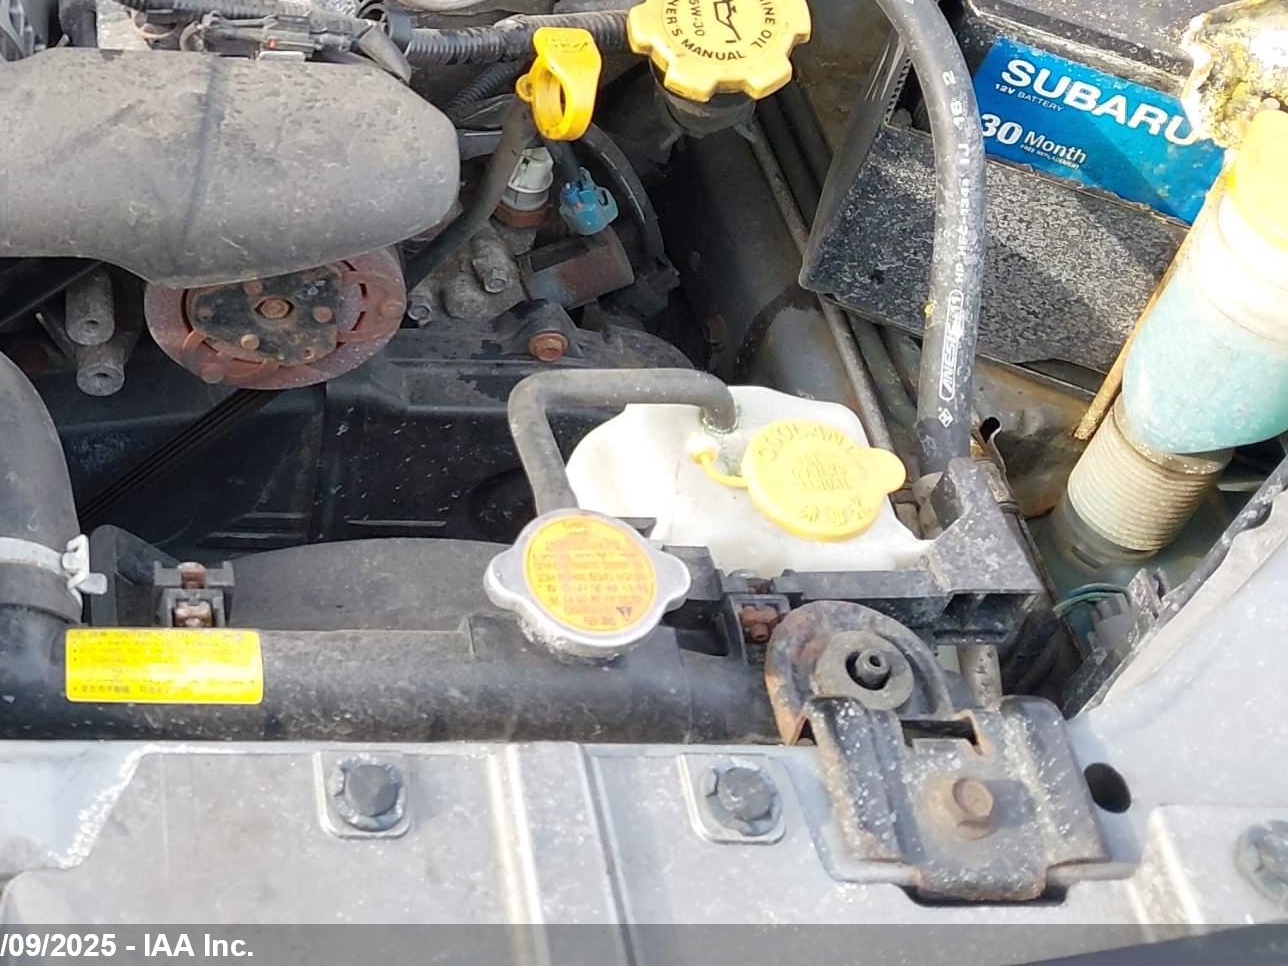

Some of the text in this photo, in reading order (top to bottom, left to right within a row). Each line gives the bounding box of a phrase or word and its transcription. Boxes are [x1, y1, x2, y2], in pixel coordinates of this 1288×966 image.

[681, 38, 746, 61] MANUAL
[750, 30, 773, 49] OIL
[942, 69, 956, 86] 2
[994, 82, 1065, 113] 12V BATTERY
[1000, 58, 1198, 146] SUBARU
[950, 100, 966, 130] 16
[981, 113, 1087, 165] 30 Month
[957, 143, 970, 164] IJ
[1019, 144, 1037, 157] FREE
[955, 264, 964, 283] HP
